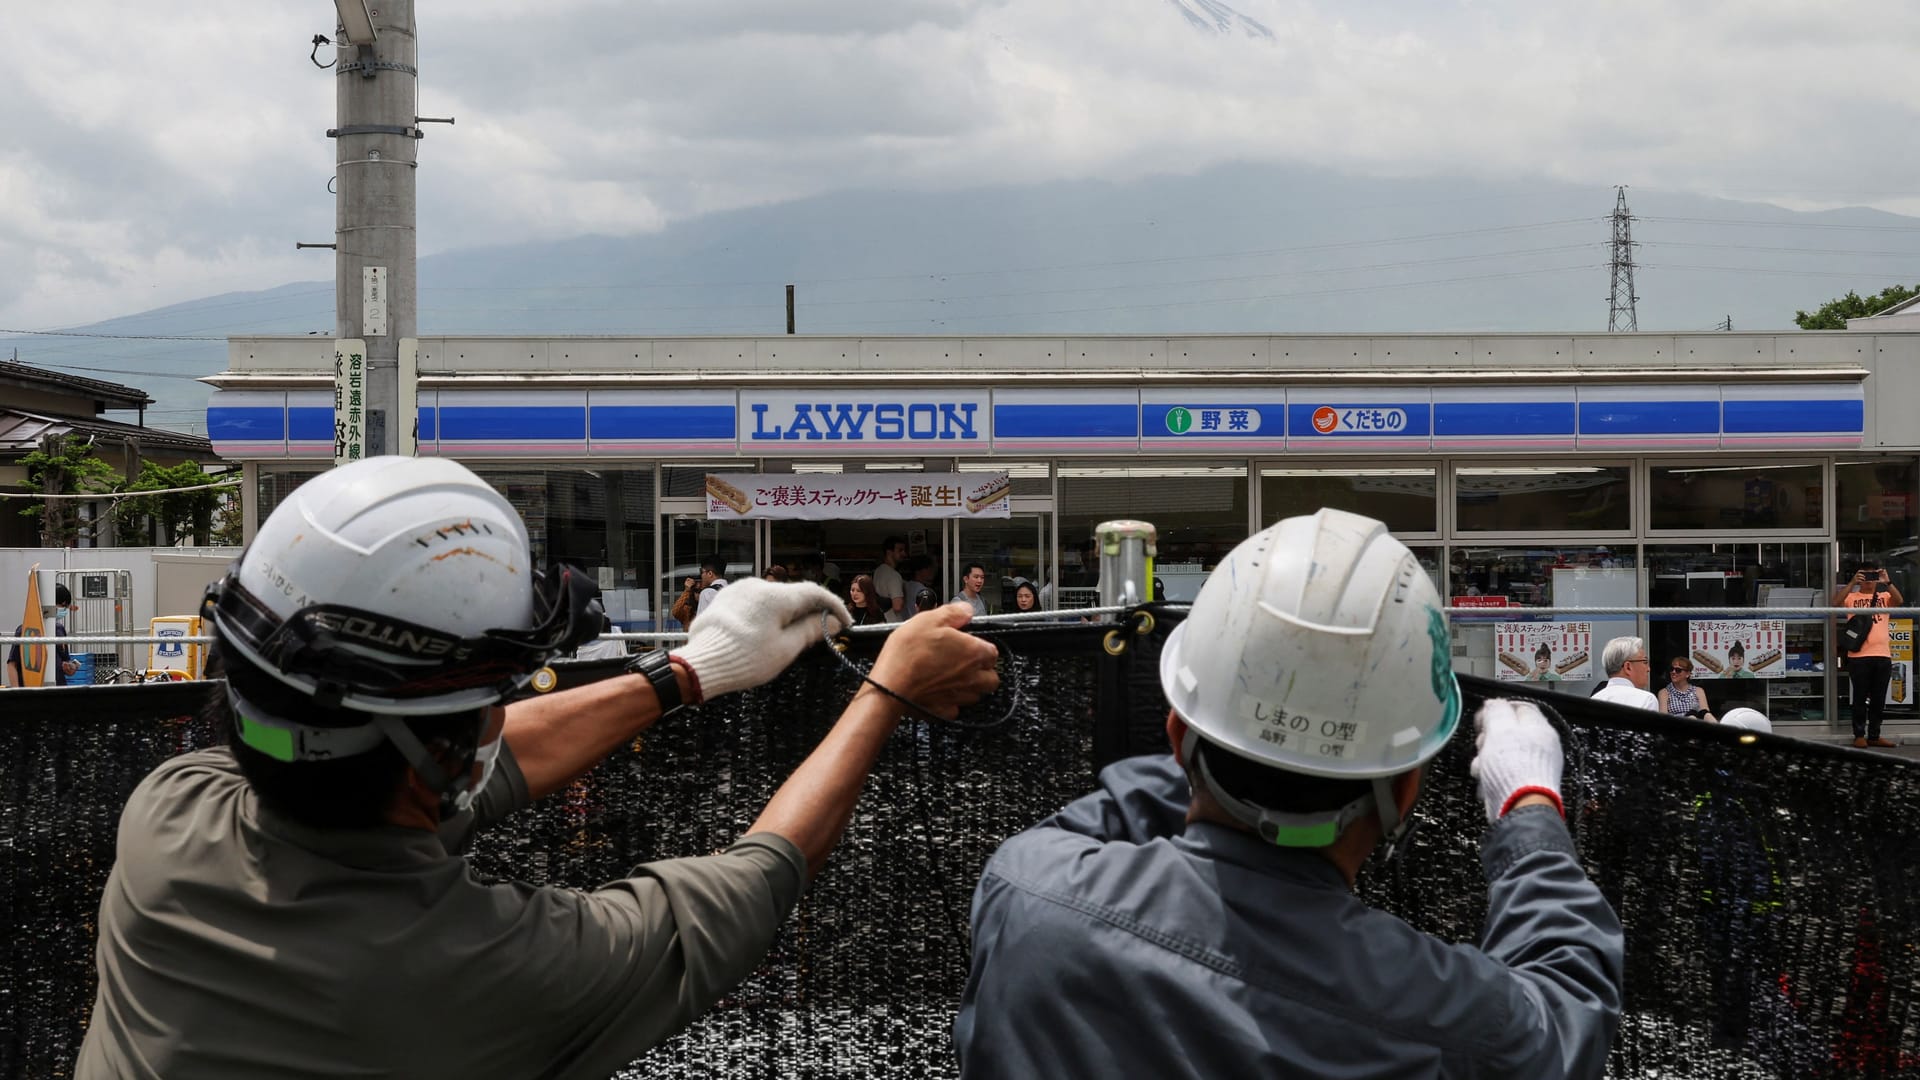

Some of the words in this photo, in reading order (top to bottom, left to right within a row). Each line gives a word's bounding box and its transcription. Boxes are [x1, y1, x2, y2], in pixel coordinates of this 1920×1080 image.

[349, 353, 362, 460] 溶岩遠赤外線
[751, 403, 978, 440] LAWSON
[1201, 410, 1249, 431] 野菜
[1341, 410, 1401, 430] くだもの
[1254, 702, 1310, 732] しまの
[1320, 720, 1358, 741] O型
